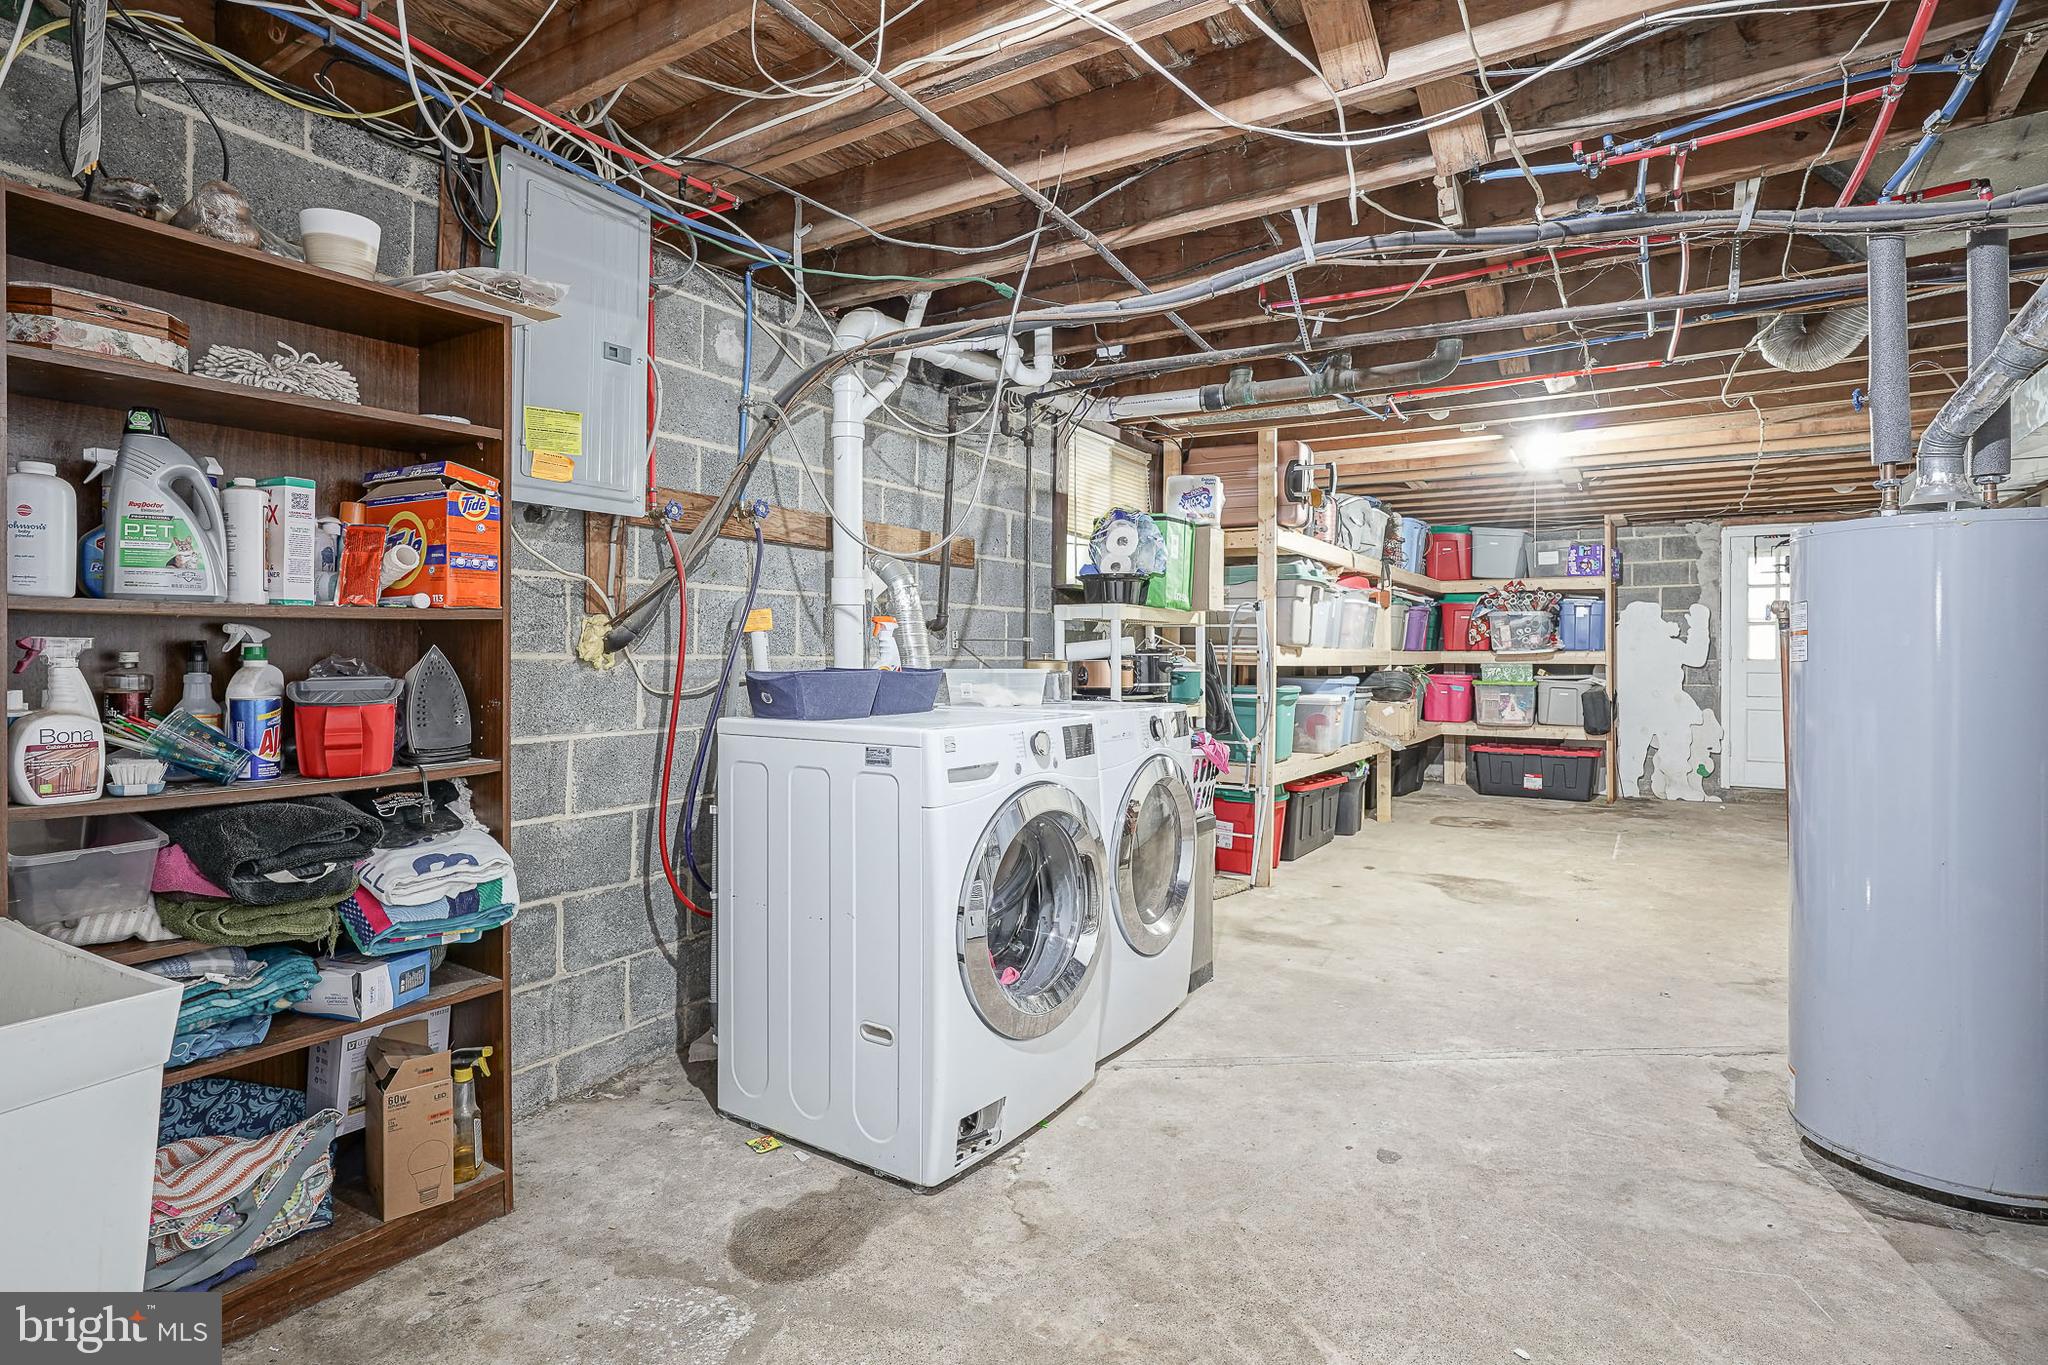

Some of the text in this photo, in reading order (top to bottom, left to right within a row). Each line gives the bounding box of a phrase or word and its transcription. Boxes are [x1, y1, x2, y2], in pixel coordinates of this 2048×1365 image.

[461, 495, 487, 514] Tide
[8, 520, 48, 531] ohnson's
[124, 523, 175, 538] PET
[432, 594, 444, 603] 113
[39, 728, 94, 745] Bona
[45, 743, 69, 751] Cabinet
[433, 1092, 447, 1101] LED
